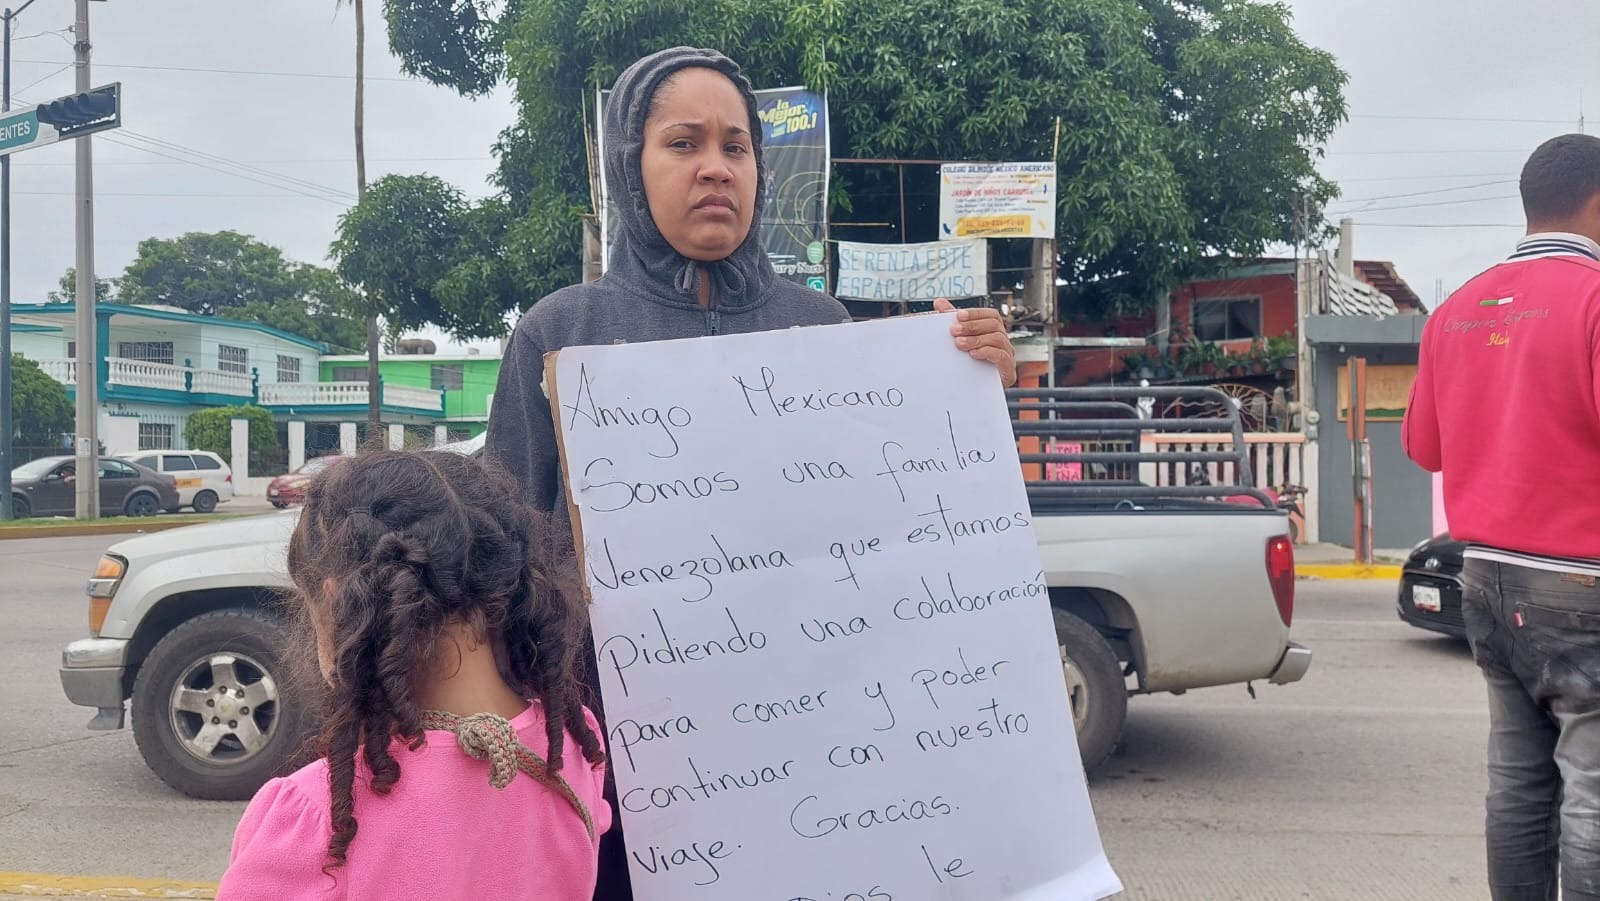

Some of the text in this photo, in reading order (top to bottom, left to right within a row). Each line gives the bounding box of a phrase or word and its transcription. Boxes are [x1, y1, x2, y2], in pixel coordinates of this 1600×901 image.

[786, 112, 818, 134] 100.1
[840, 244, 974, 272] SE RENTA ESTE
[839, 276, 919, 299] ESPACIO
[562, 362, 904, 458] Amigo Mexicano
[580, 410, 996, 512] Somos una familia
[588, 493, 1030, 602] Venezolana que estamos
[800, 616, 872, 642] una
[893, 570, 1048, 621] colaboración
[732, 690, 828, 723] comer
[864, 682, 895, 731] y
[622, 698, 1029, 812] continuar con nuestro
[790, 795, 960, 838] Gracias.
[921, 844, 975, 884] le
